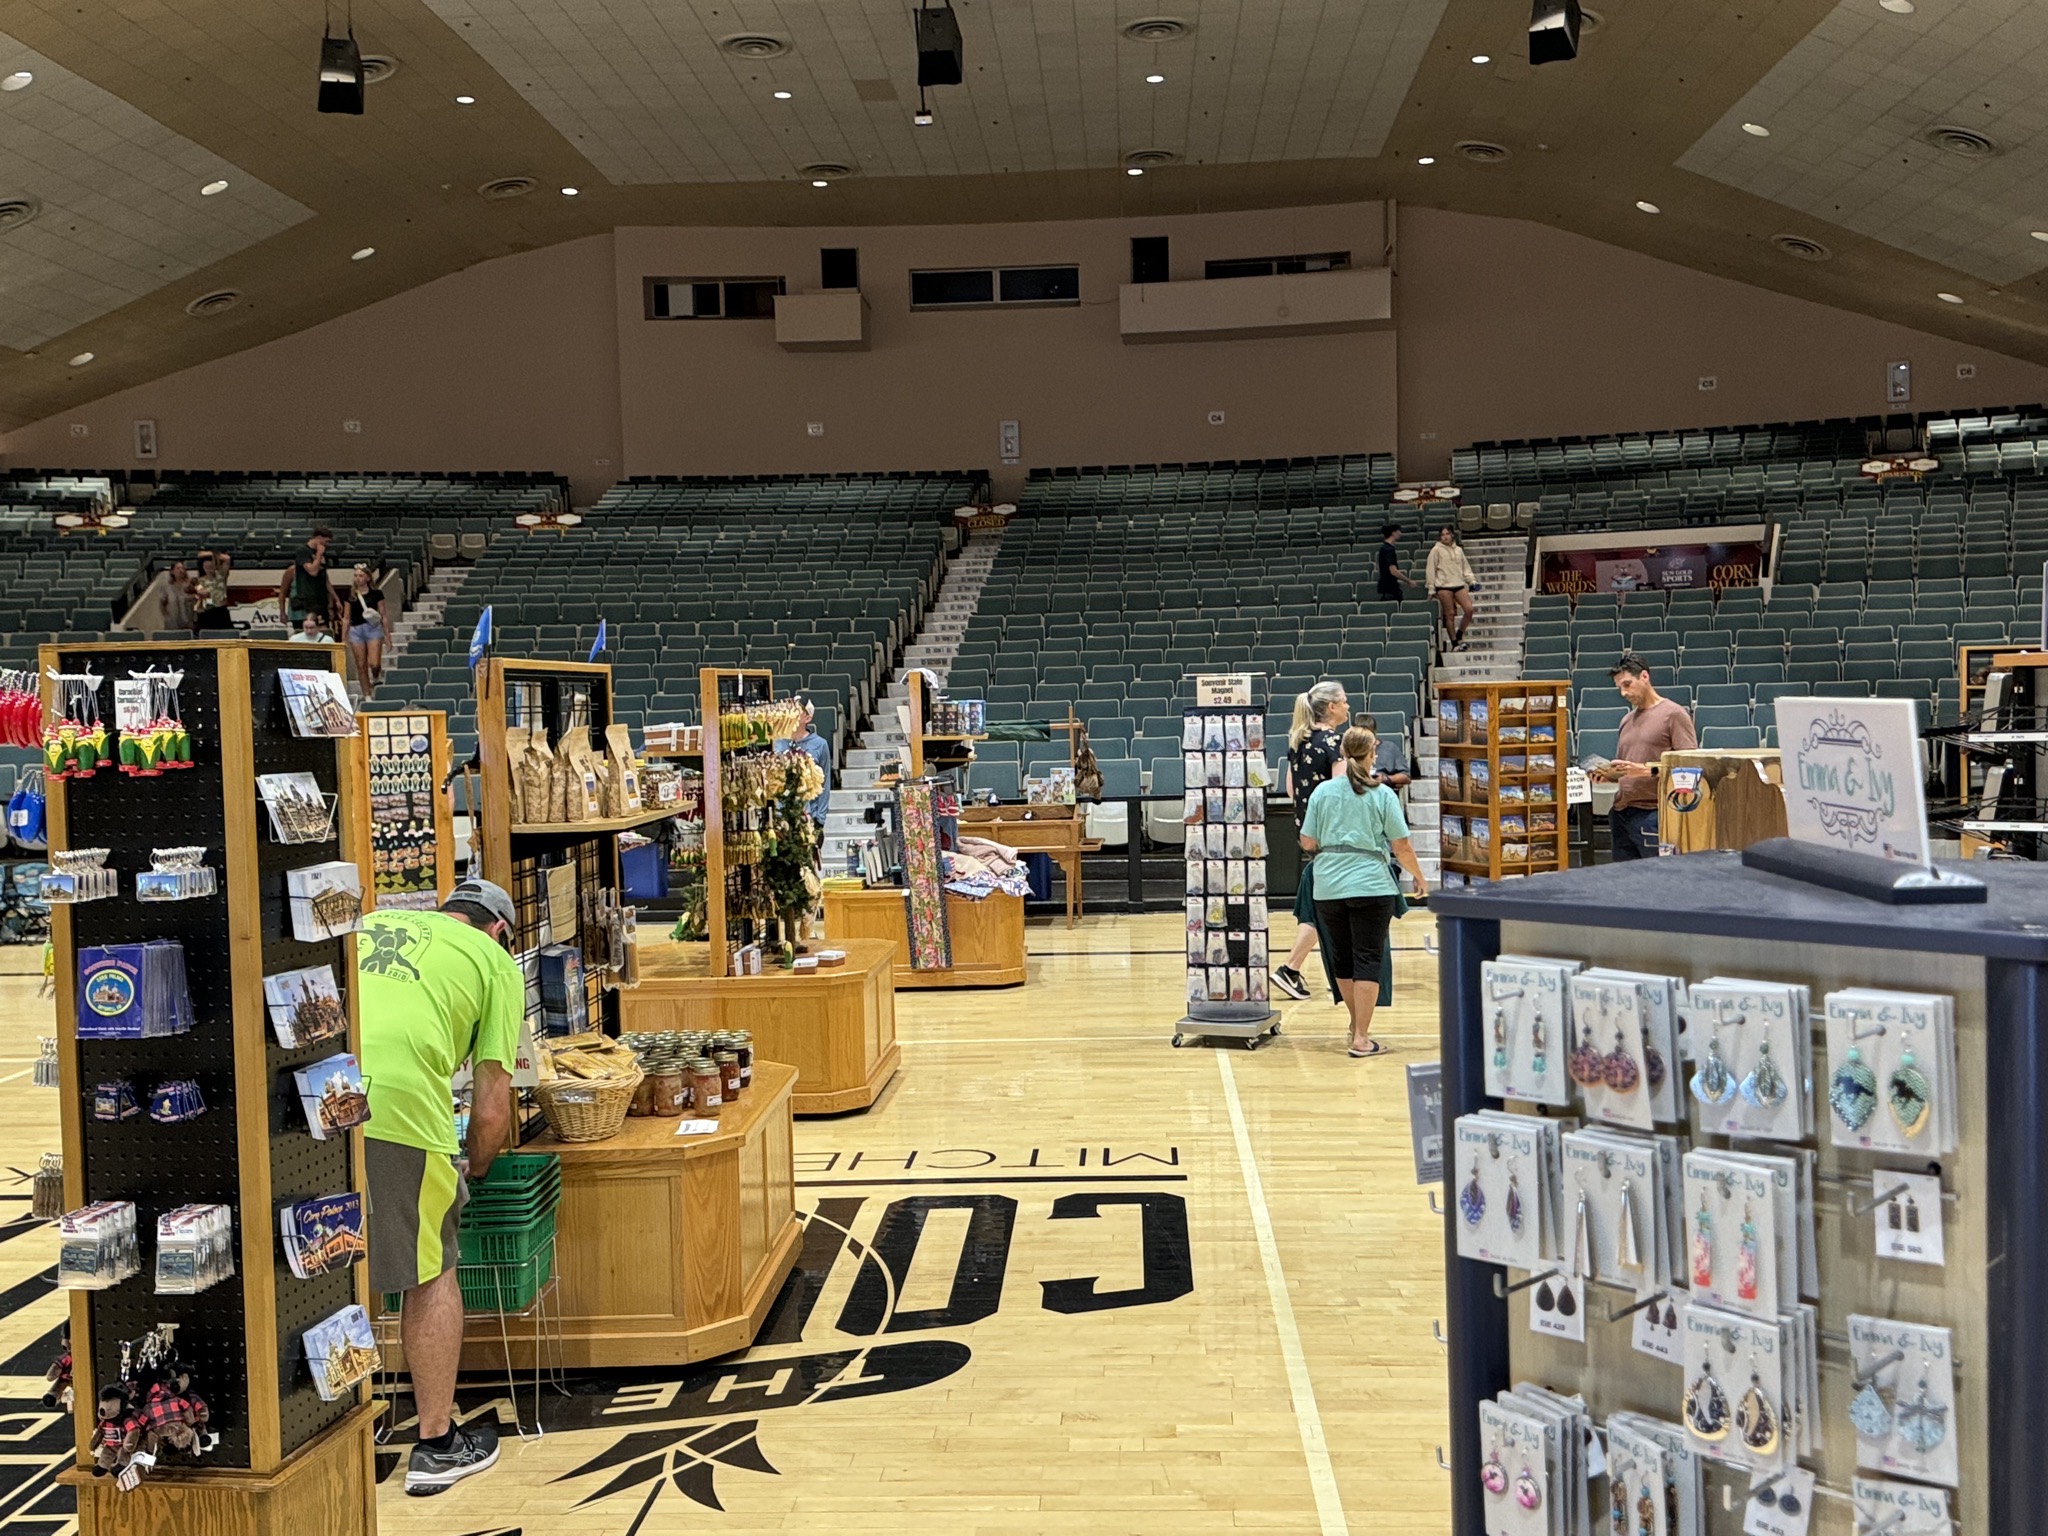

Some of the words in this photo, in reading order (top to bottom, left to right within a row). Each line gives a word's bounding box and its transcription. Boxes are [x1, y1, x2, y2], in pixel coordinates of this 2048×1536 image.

[1211, 414, 1222, 422] C4
[1559, 570, 1582, 582] THE
[1662, 575, 1694, 583] SPORTS
[1713, 563, 1754, 581] CORN
[1201, 678, 1227, 687] Souvenir
[1228, 678, 1243, 686] State
[1211, 687, 1234, 695] Magnet
[1214, 696, 1232, 705] $2.49
[1797, 751, 1841, 795] Emma
[1844, 756, 1863, 796] &
[1865, 757, 1895, 818] Ivy
[387, 970, 407, 980] 2010
[1538, 973, 1556, 993] Ivy
[1739, 996, 1755, 1011] &
[1760, 996, 1784, 1018] Ivy
[1877, 1006, 1896, 1022] &
[1901, 1006, 1926, 1030] Ivy
[1512, 1133, 1531, 1156] Ivy
[1625, 1154, 1646, 1178] Ivy
[1745, 1172, 1766, 1198] Ivy
[320, 1204, 344, 1220] Palace
[345, 1199, 359, 1212] 2013
[1752, 1328, 1774, 1354] Ivy
[1853, 1325, 1893, 1346] Emma
[1897, 1332, 1916, 1348] &
[1920, 1333, 1945, 1359] Ivy
[602, 1357, 884, 1414] THE
[1524, 1425, 1539, 1450] Ivy
[1644, 1444, 1658, 1473] Ivy
[1856, 1482, 1895, 1504] Emma
[1898, 1490, 1914, 1507] &
[1918, 1492, 1942, 1519] Ivy
